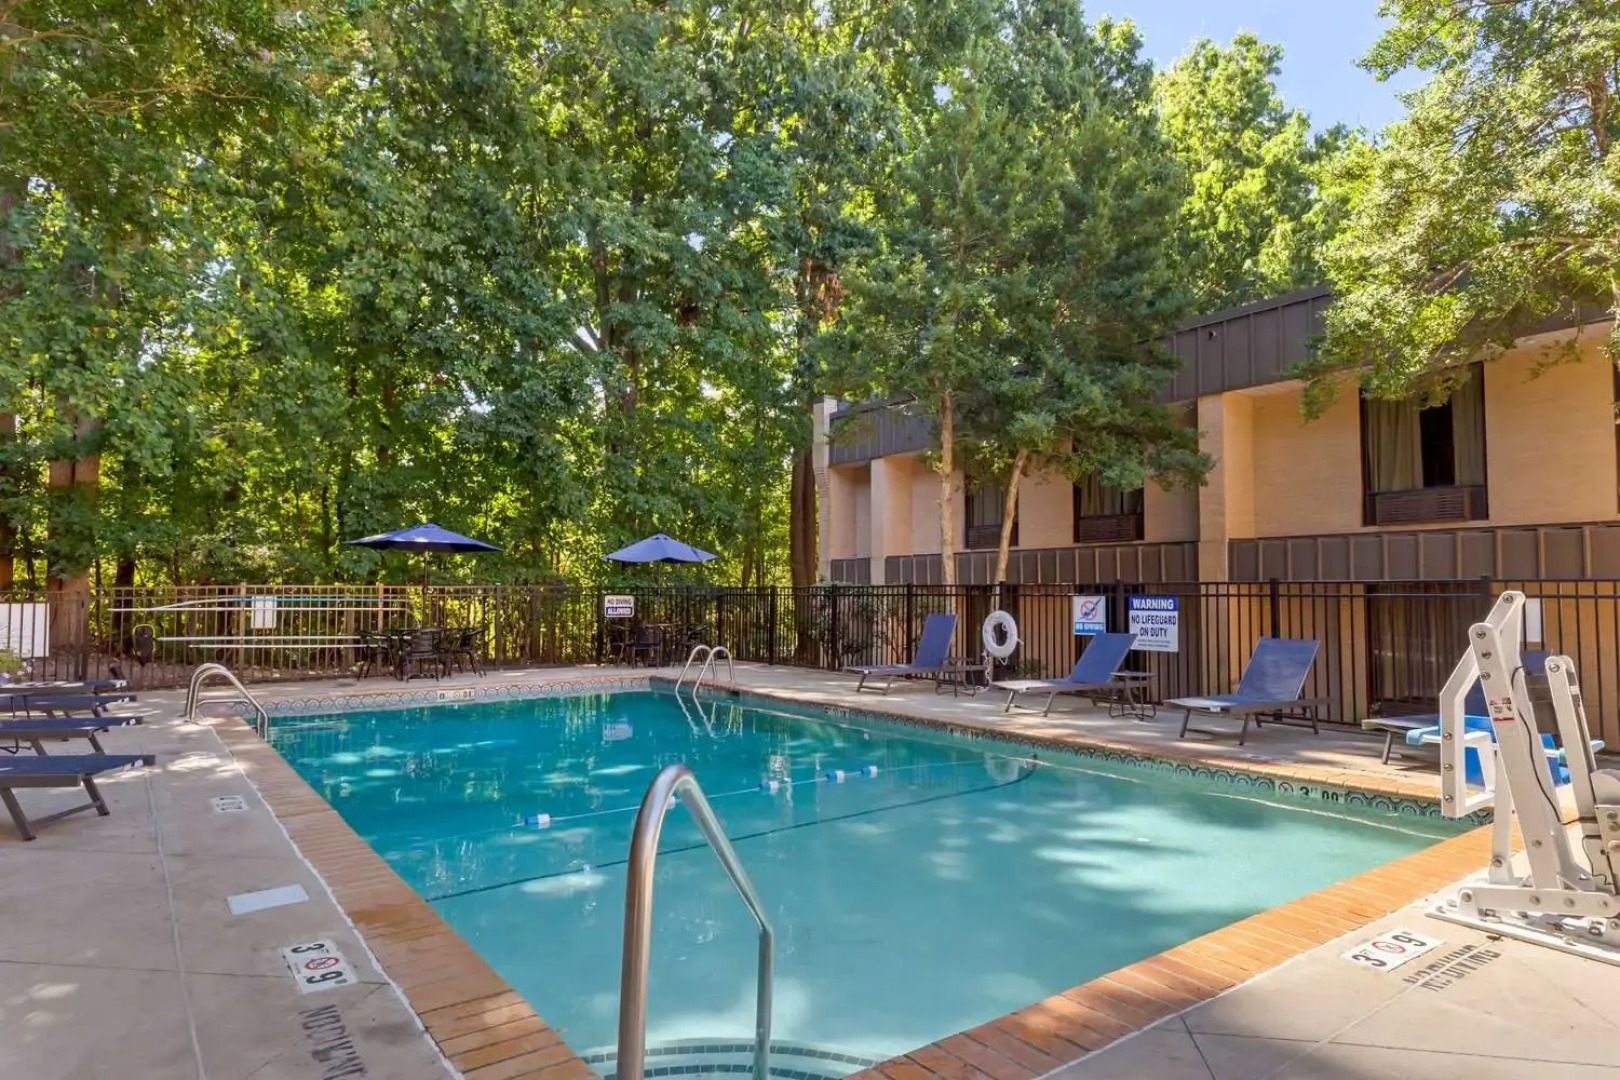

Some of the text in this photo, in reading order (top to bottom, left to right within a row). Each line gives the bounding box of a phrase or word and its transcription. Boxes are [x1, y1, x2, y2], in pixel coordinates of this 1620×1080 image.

[1132, 598, 1174, 609] WARNING
[1131, 615, 1177, 625] NO LIFEGUARD
[1139, 627, 1168, 637] ON DUTY
